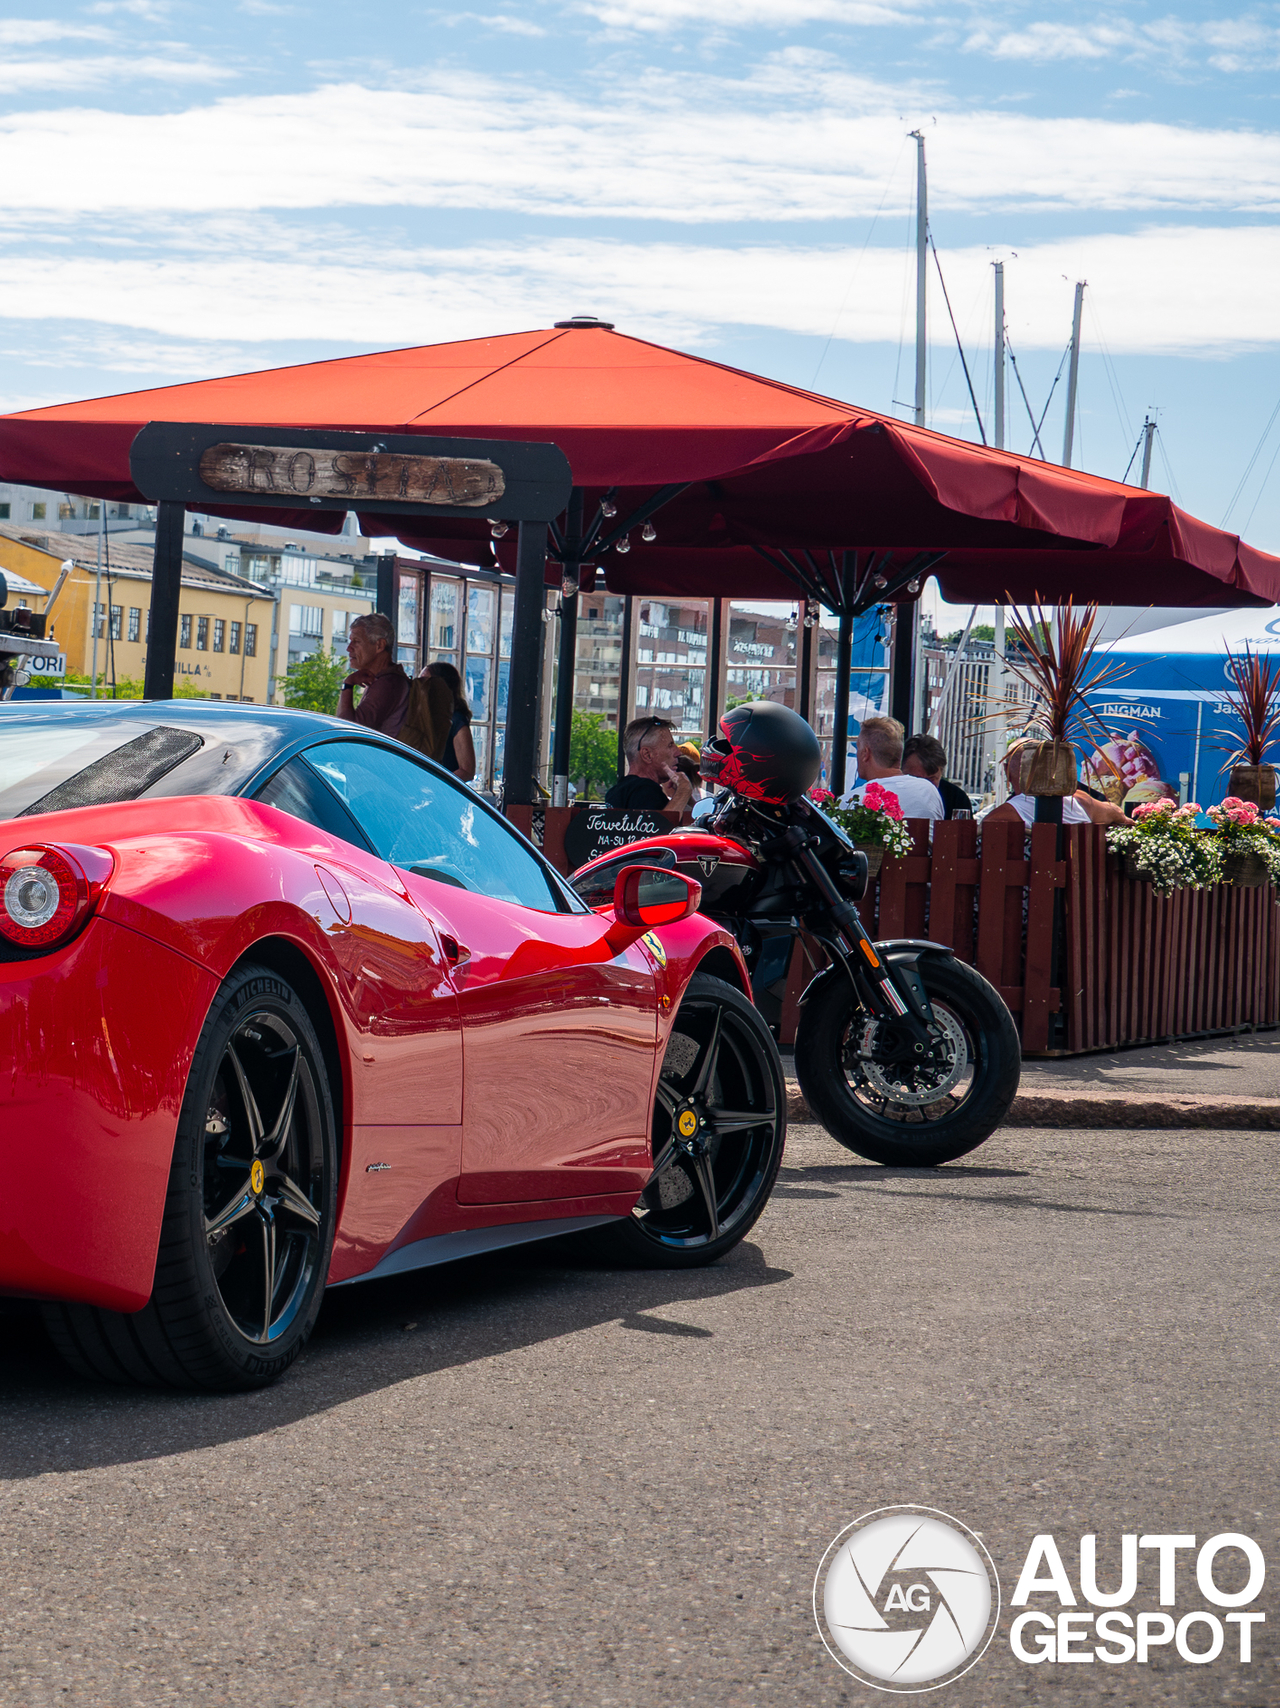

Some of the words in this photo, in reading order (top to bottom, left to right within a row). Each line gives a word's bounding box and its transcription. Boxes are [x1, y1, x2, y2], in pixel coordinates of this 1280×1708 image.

[248, 449, 456, 500] ROSITA
[1102, 704, 1162, 718] INGMAN
[597, 835, 625, 846] MA-SU
[236, 978, 290, 1008] MICHELIN
